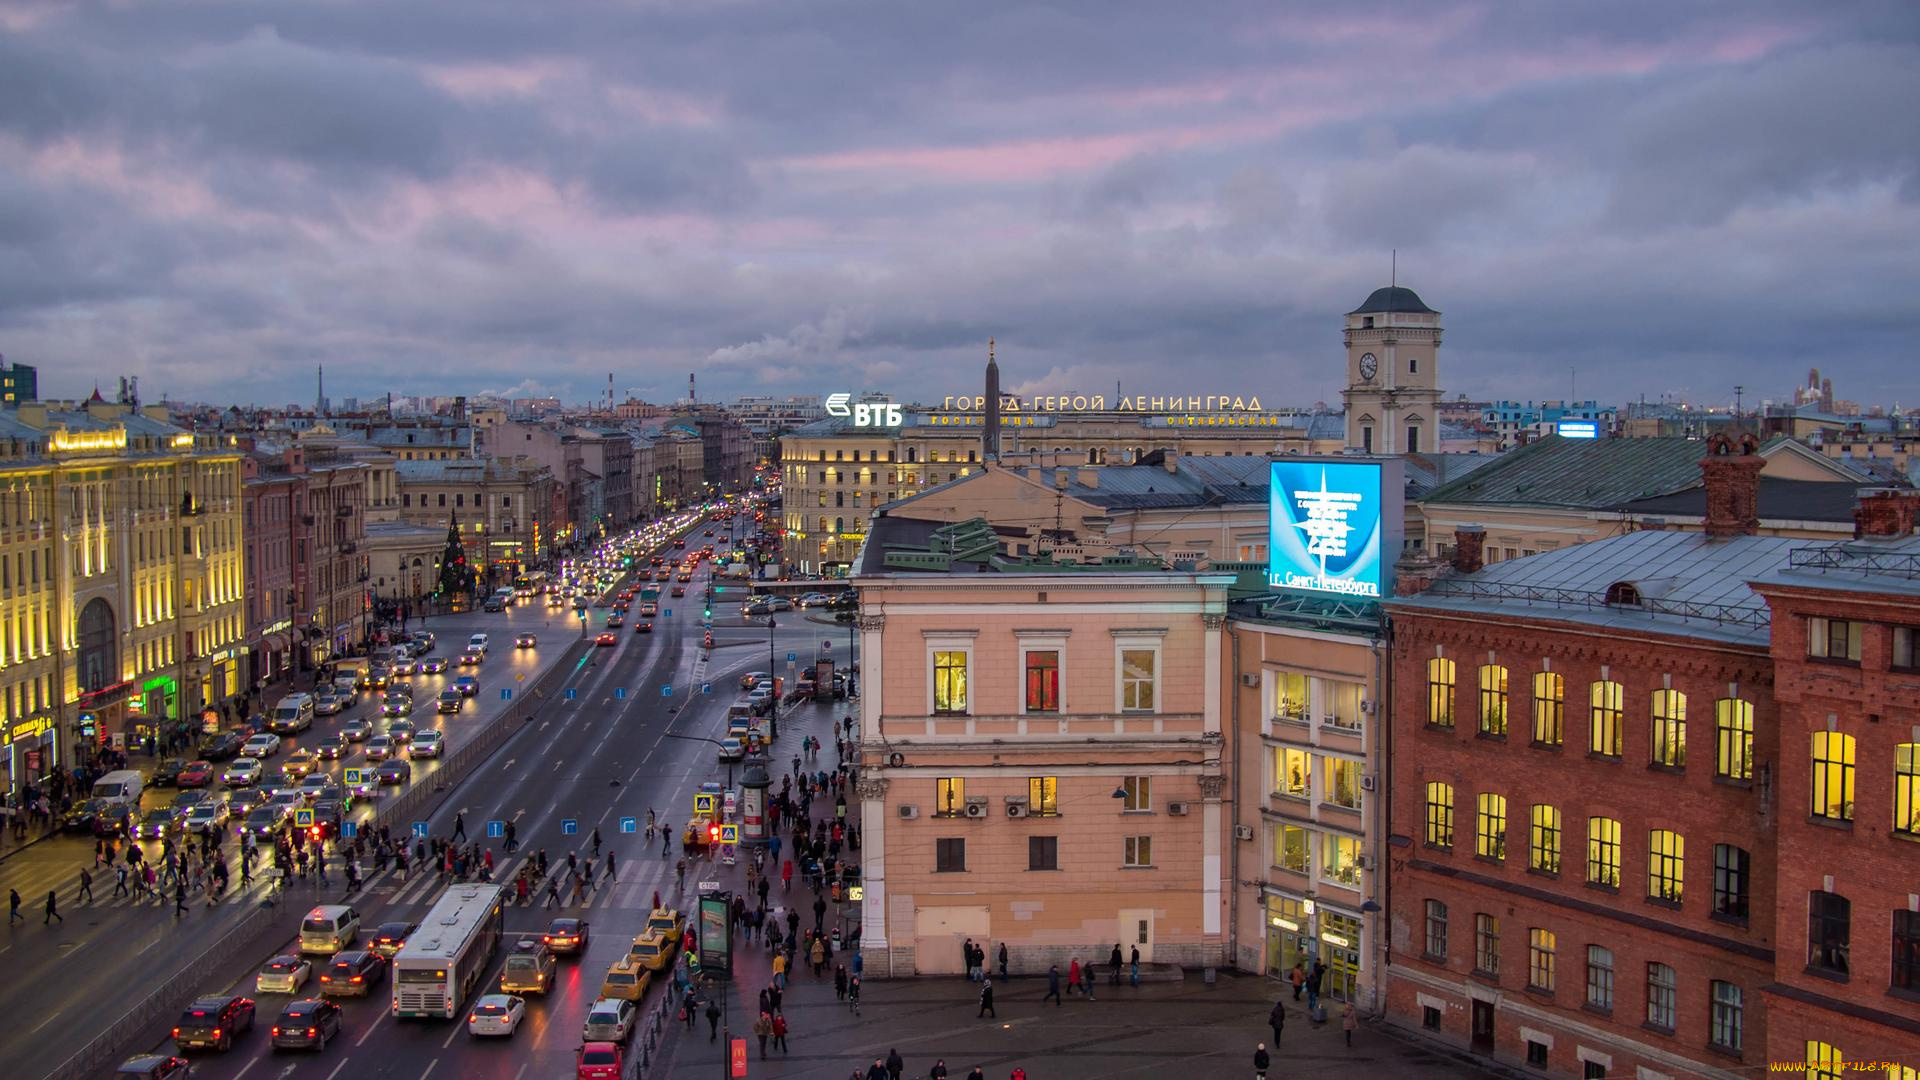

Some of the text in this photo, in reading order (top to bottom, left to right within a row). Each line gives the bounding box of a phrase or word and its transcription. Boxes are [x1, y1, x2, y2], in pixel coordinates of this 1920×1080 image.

[945, 395, 1262, 411] ГОРД-ГЕРОЙ ЛЕНИНГРАД
[855, 404, 903, 427] ВТБ
[931, 416, 1278, 426] ГОСТИИЦА ОКТЯБРЬСКАЯ
[1285, 571, 1377, 596] Санкт-Петербурга
